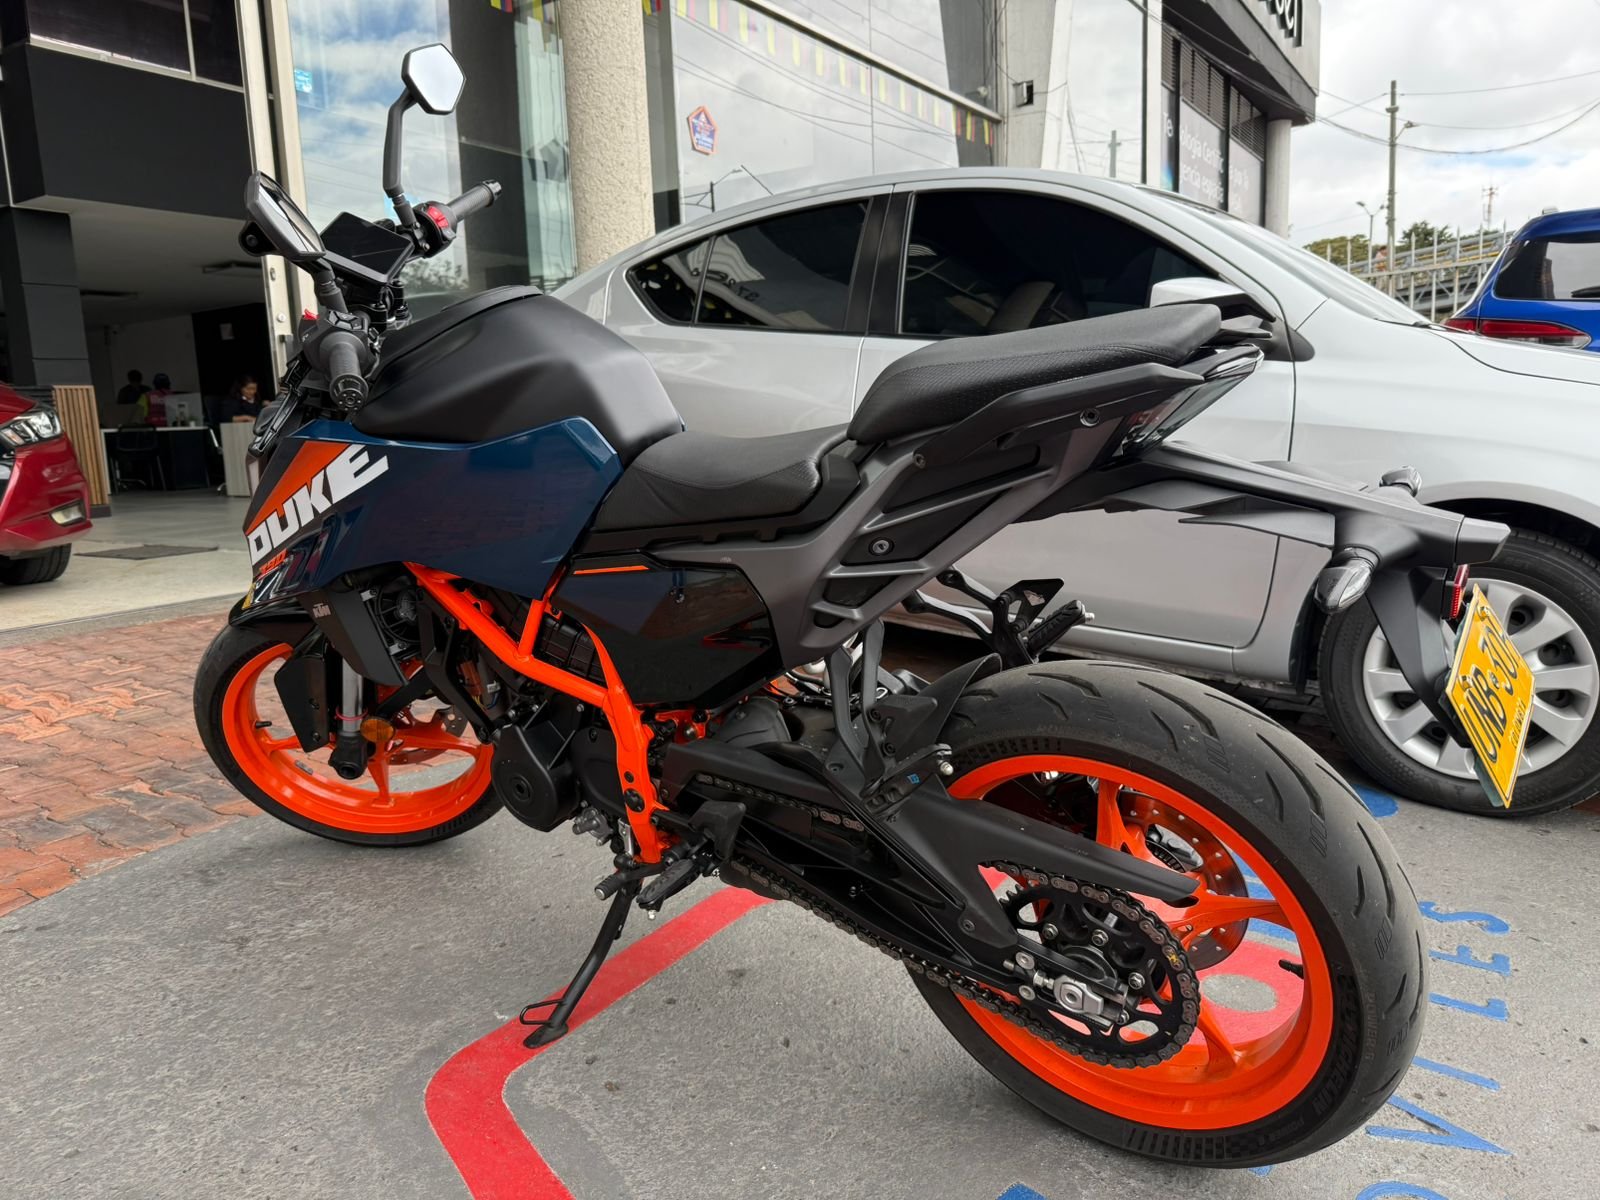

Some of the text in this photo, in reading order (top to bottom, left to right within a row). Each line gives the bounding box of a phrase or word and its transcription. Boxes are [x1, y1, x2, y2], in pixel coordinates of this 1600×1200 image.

[247, 444, 389, 566] DUKE
[312, 603, 331, 618] KTM
[1461, 664, 1507, 763] UNB
